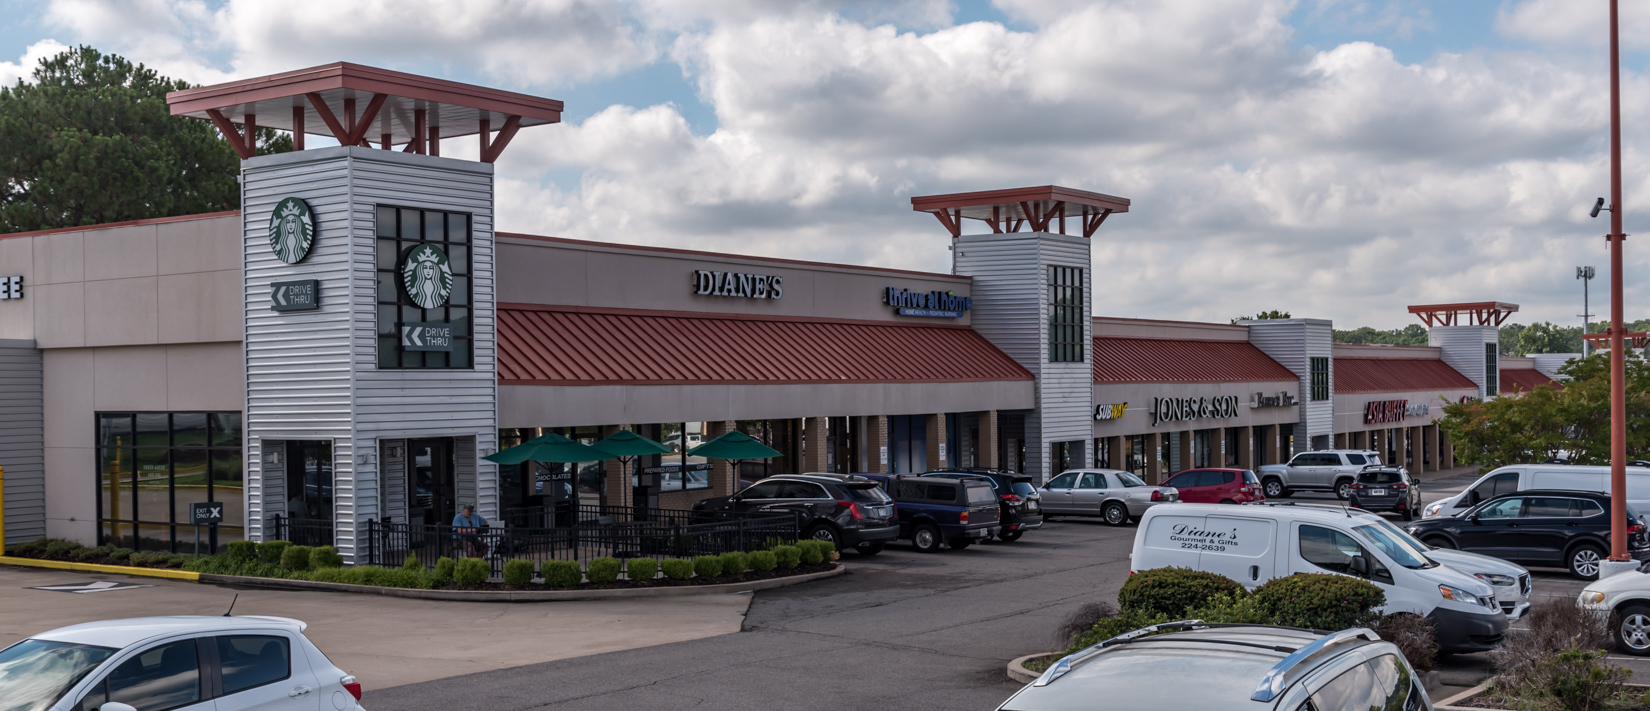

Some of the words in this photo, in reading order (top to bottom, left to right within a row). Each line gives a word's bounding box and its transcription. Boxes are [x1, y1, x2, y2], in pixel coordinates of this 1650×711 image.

[289, 285, 311, 295] DRIVE
[697, 270, 783, 300] DIANE'S
[290, 295, 311, 305] THRU
[888, 286, 926, 308] thrive
[928, 290, 939, 309] at
[941, 290, 972, 311] home
[425, 327, 450, 337] DRIVE
[426, 337, 449, 347] THRU
[1096, 402, 1127, 419] SUBWAY
[1153, 397, 1197, 426] JONES
[1200, 397, 1211, 418] &
[1212, 396, 1239, 418] SON
[1366, 401, 1385, 424] ASIA
[1172, 523, 1237, 539] Diane's
[1170, 535, 1206, 543] Gourmet
[1181, 542, 1226, 551] 224-2639
